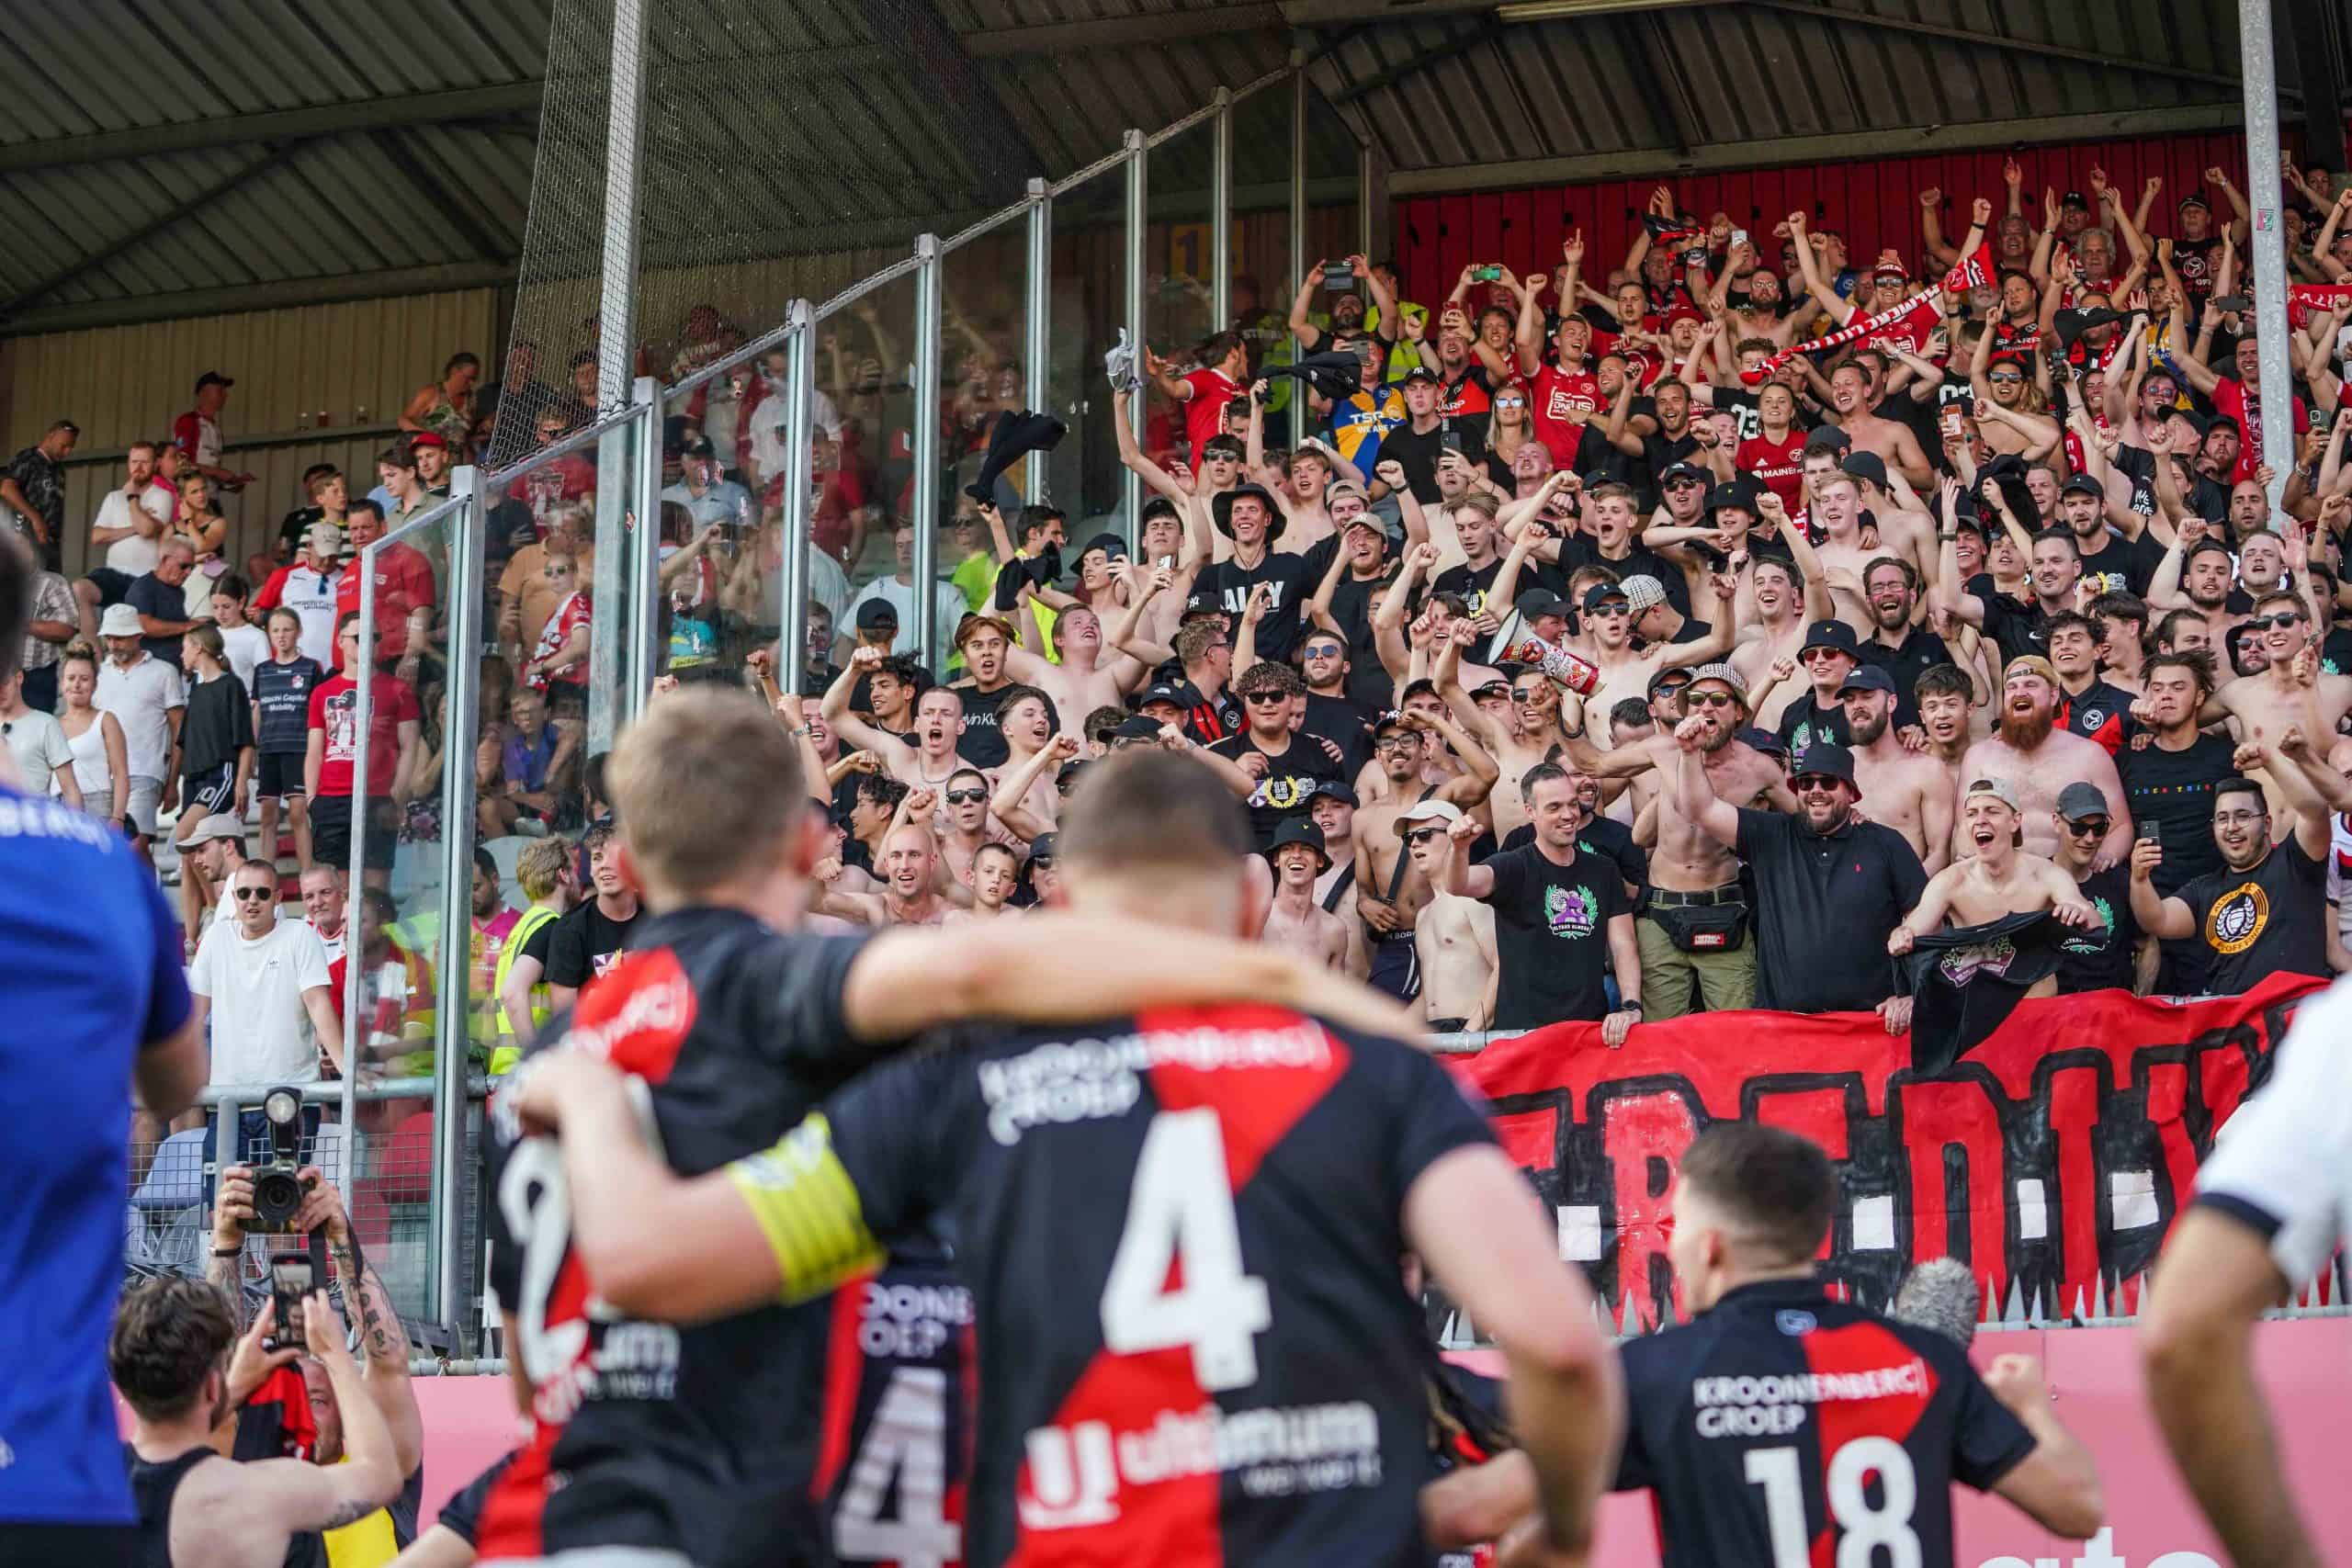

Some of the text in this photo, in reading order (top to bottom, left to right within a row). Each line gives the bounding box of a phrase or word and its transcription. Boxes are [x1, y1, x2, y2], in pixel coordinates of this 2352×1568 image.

[1103, 1108, 1272, 1392] 4
[1692, 1357, 1928, 1407] KROONENBERG
[1695, 1403, 1806, 1438] GROEP
[831, 1365, 963, 1568] 4
[1743, 1435, 1923, 1568] 18
